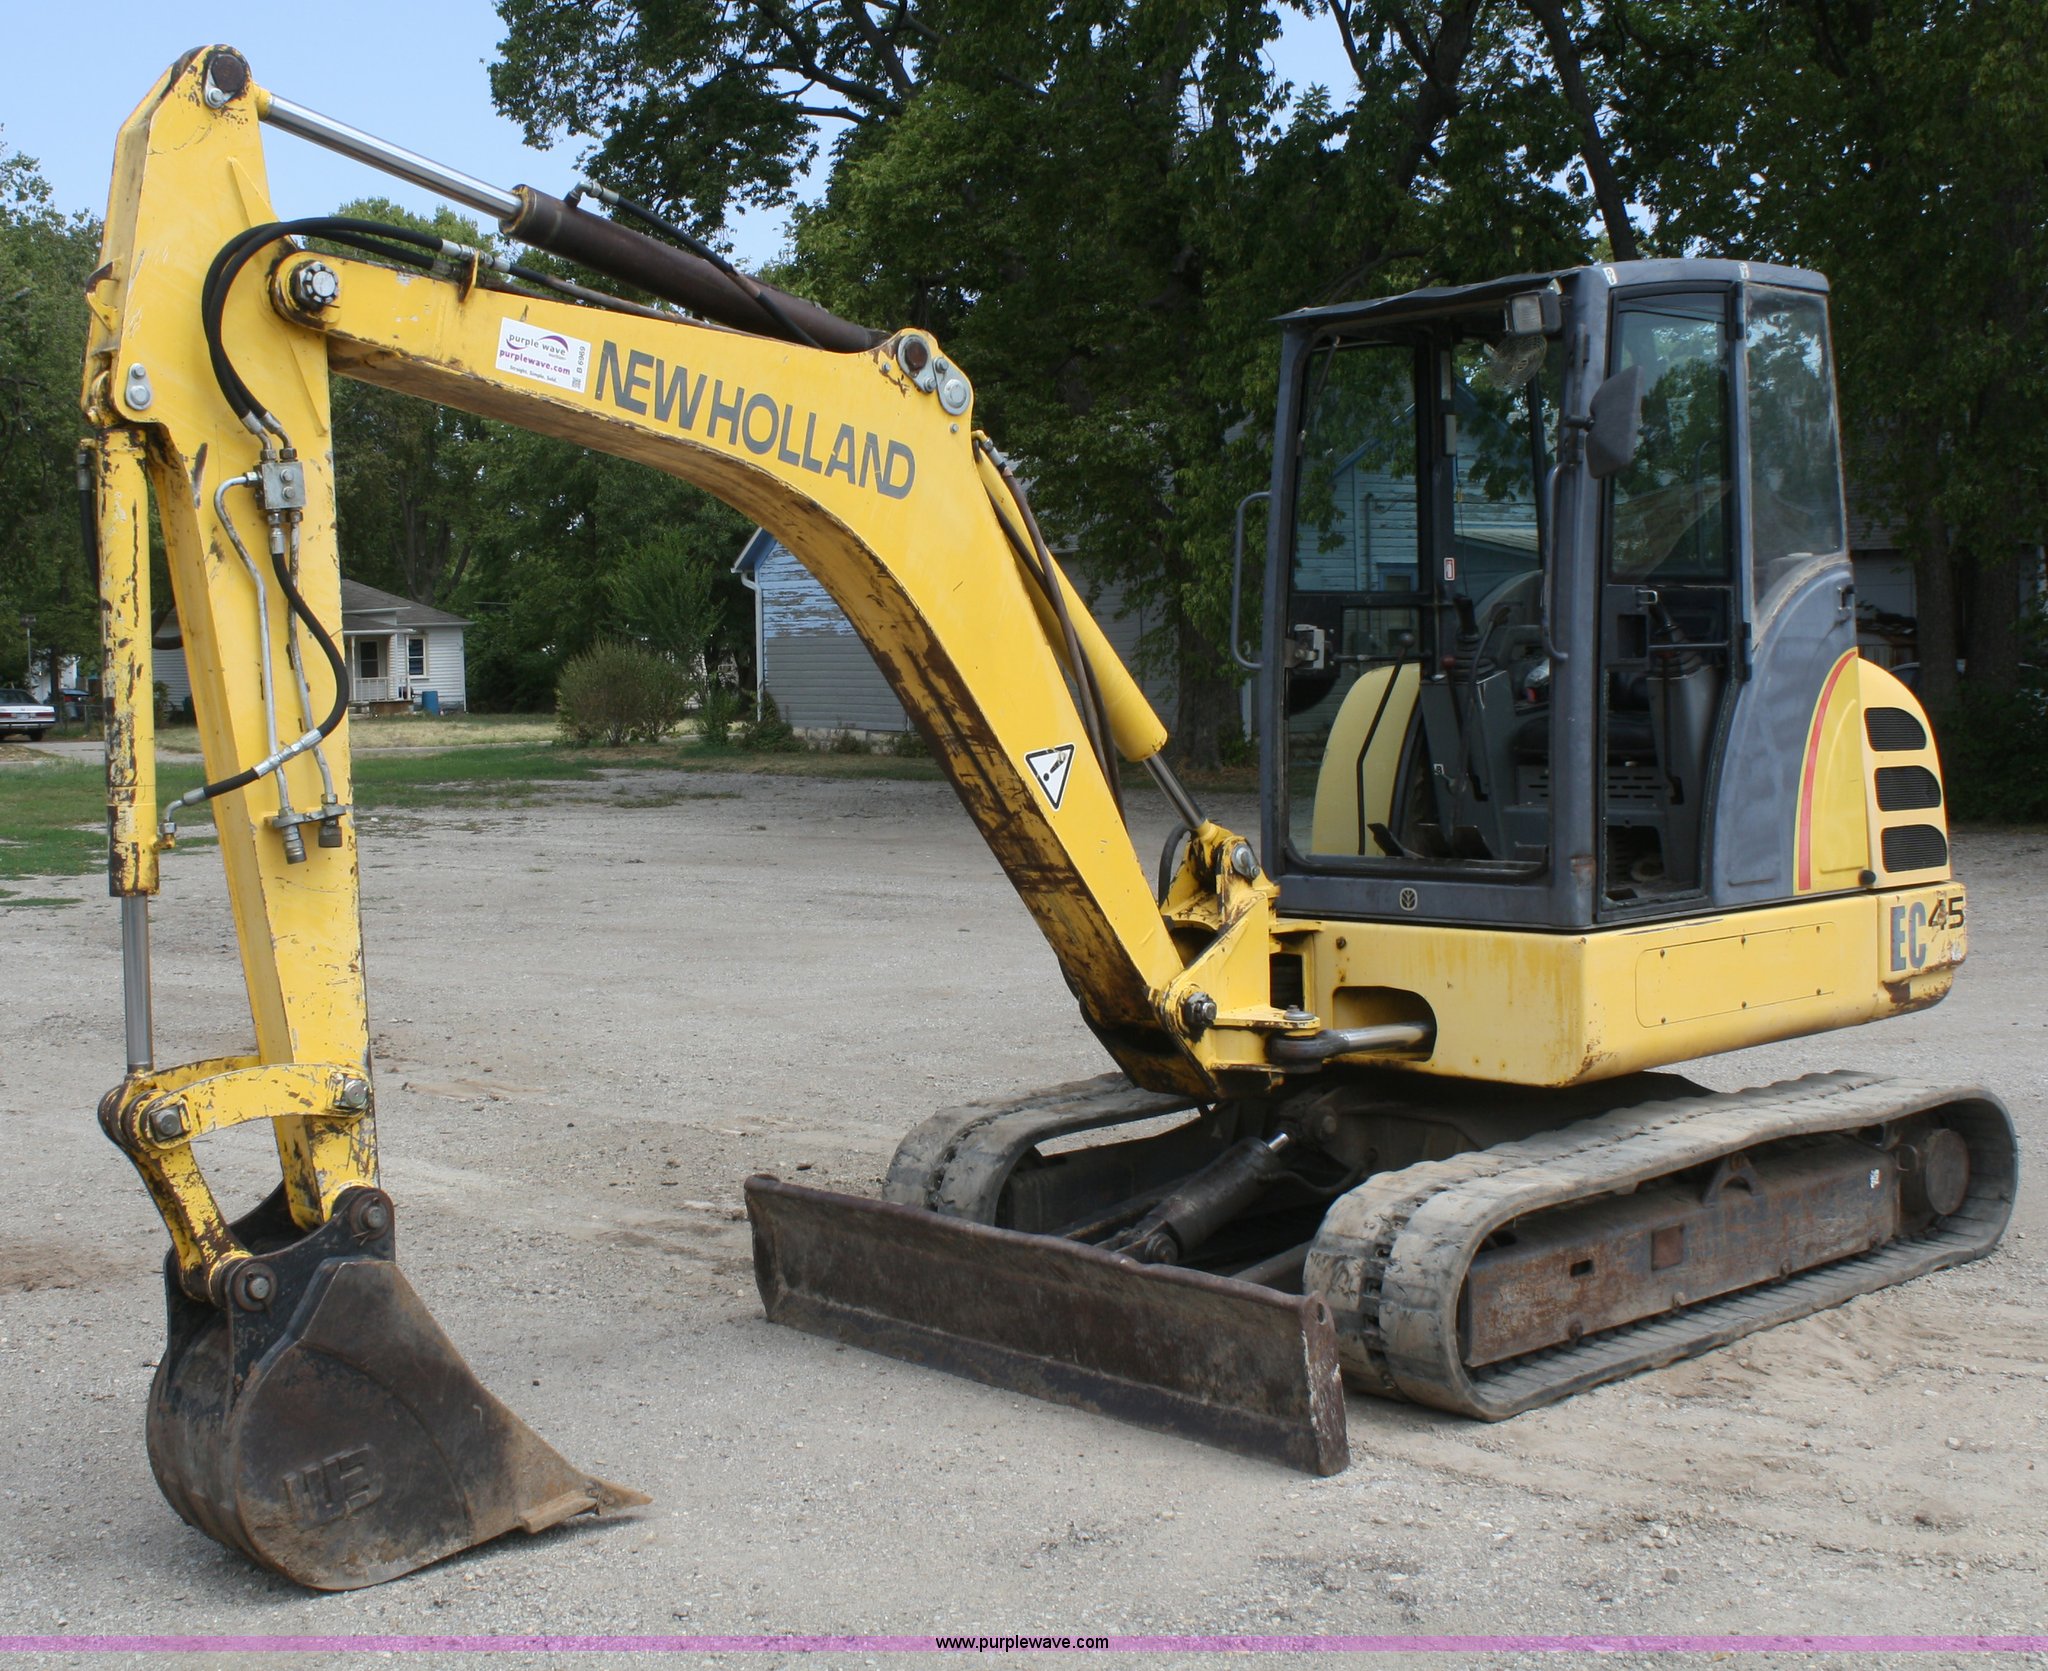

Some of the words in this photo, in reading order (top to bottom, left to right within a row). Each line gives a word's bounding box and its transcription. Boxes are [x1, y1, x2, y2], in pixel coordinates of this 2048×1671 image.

[500, 349, 571, 375] purplewave.com
[508, 334, 539, 348] purple
[542, 343, 566, 356] wave
[594, 340, 708, 430] NEW
[707, 379, 916, 500] HOLLAND
[1890, 901, 1927, 972] EC
